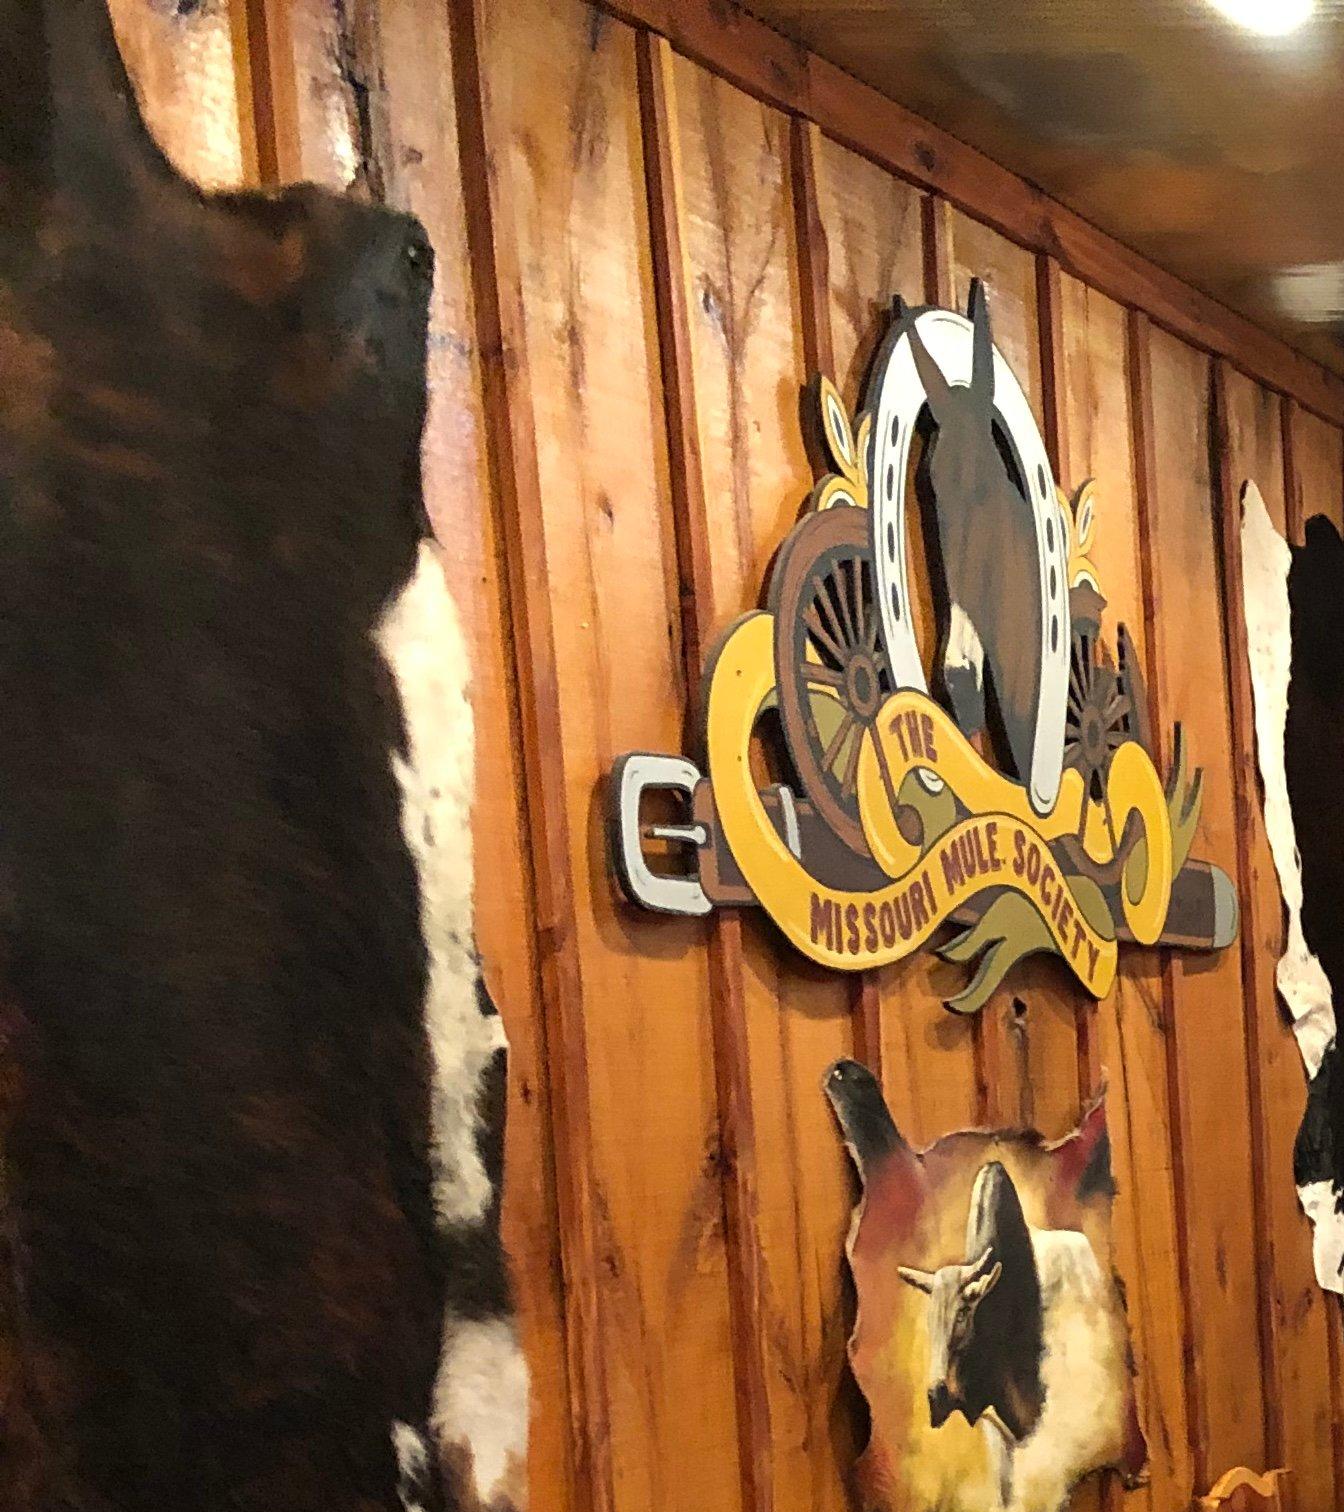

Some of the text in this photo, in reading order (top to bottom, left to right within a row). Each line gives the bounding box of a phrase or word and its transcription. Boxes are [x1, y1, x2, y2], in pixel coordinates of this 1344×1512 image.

[889, 710, 937, 762] THE
[810, 869, 938, 955] MISSOURI
[1012, 828, 1101, 983] SOCIETY
